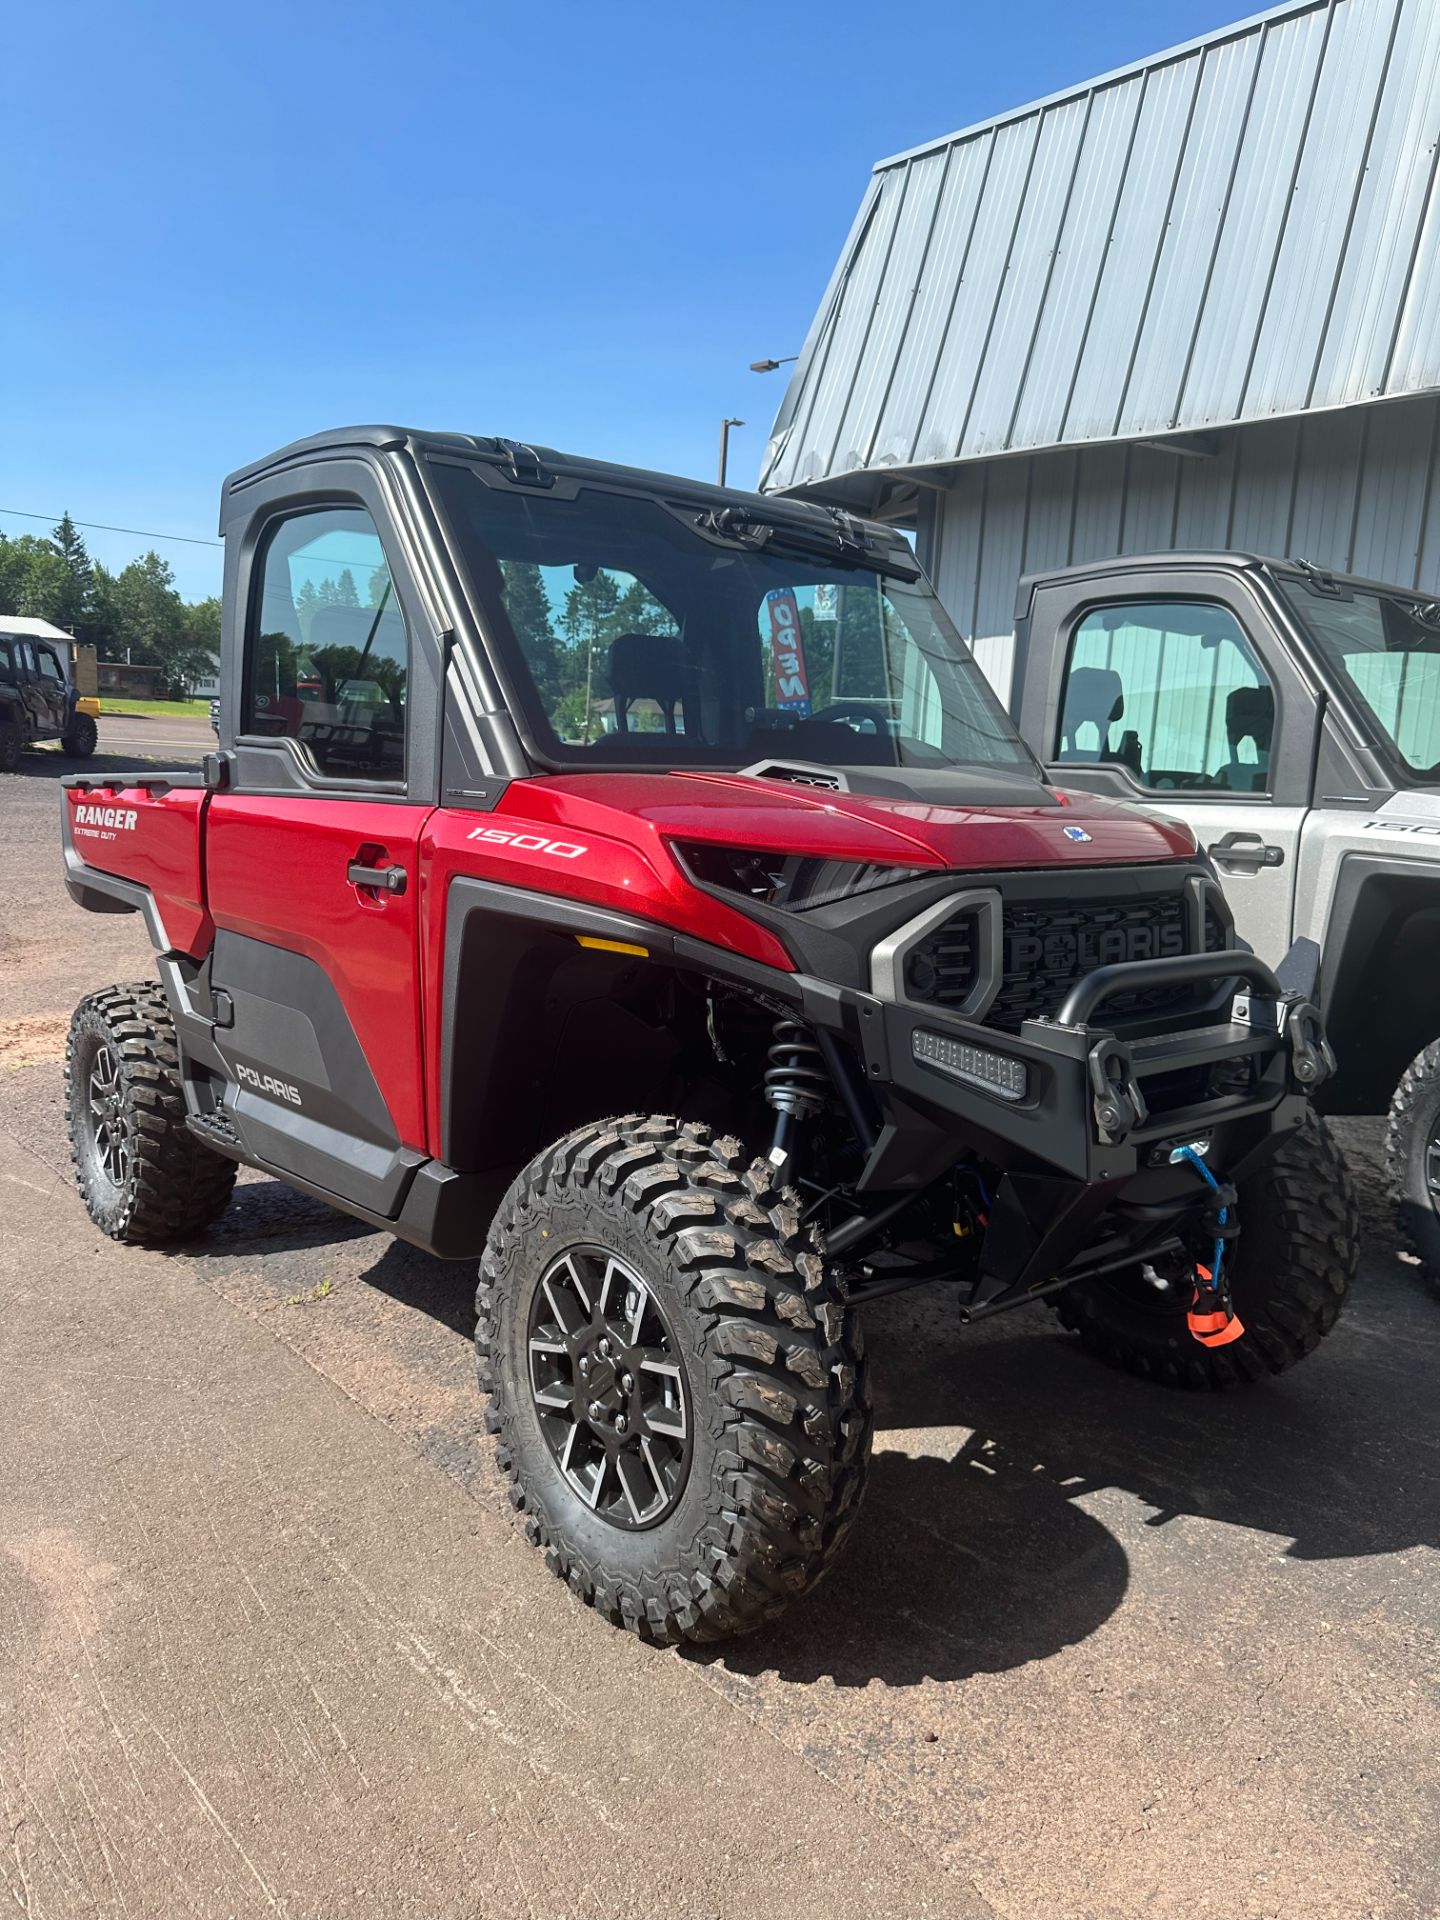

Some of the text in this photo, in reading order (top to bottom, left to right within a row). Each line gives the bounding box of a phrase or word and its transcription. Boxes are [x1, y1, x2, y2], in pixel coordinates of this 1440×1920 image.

[74, 827, 117, 840] EXTREME DUTY
[75, 805, 138, 831] RANGER
[466, 827, 588, 858] 1500
[1010, 924, 1183, 972] POLARIS
[235, 1063, 302, 1106] POLARIS
